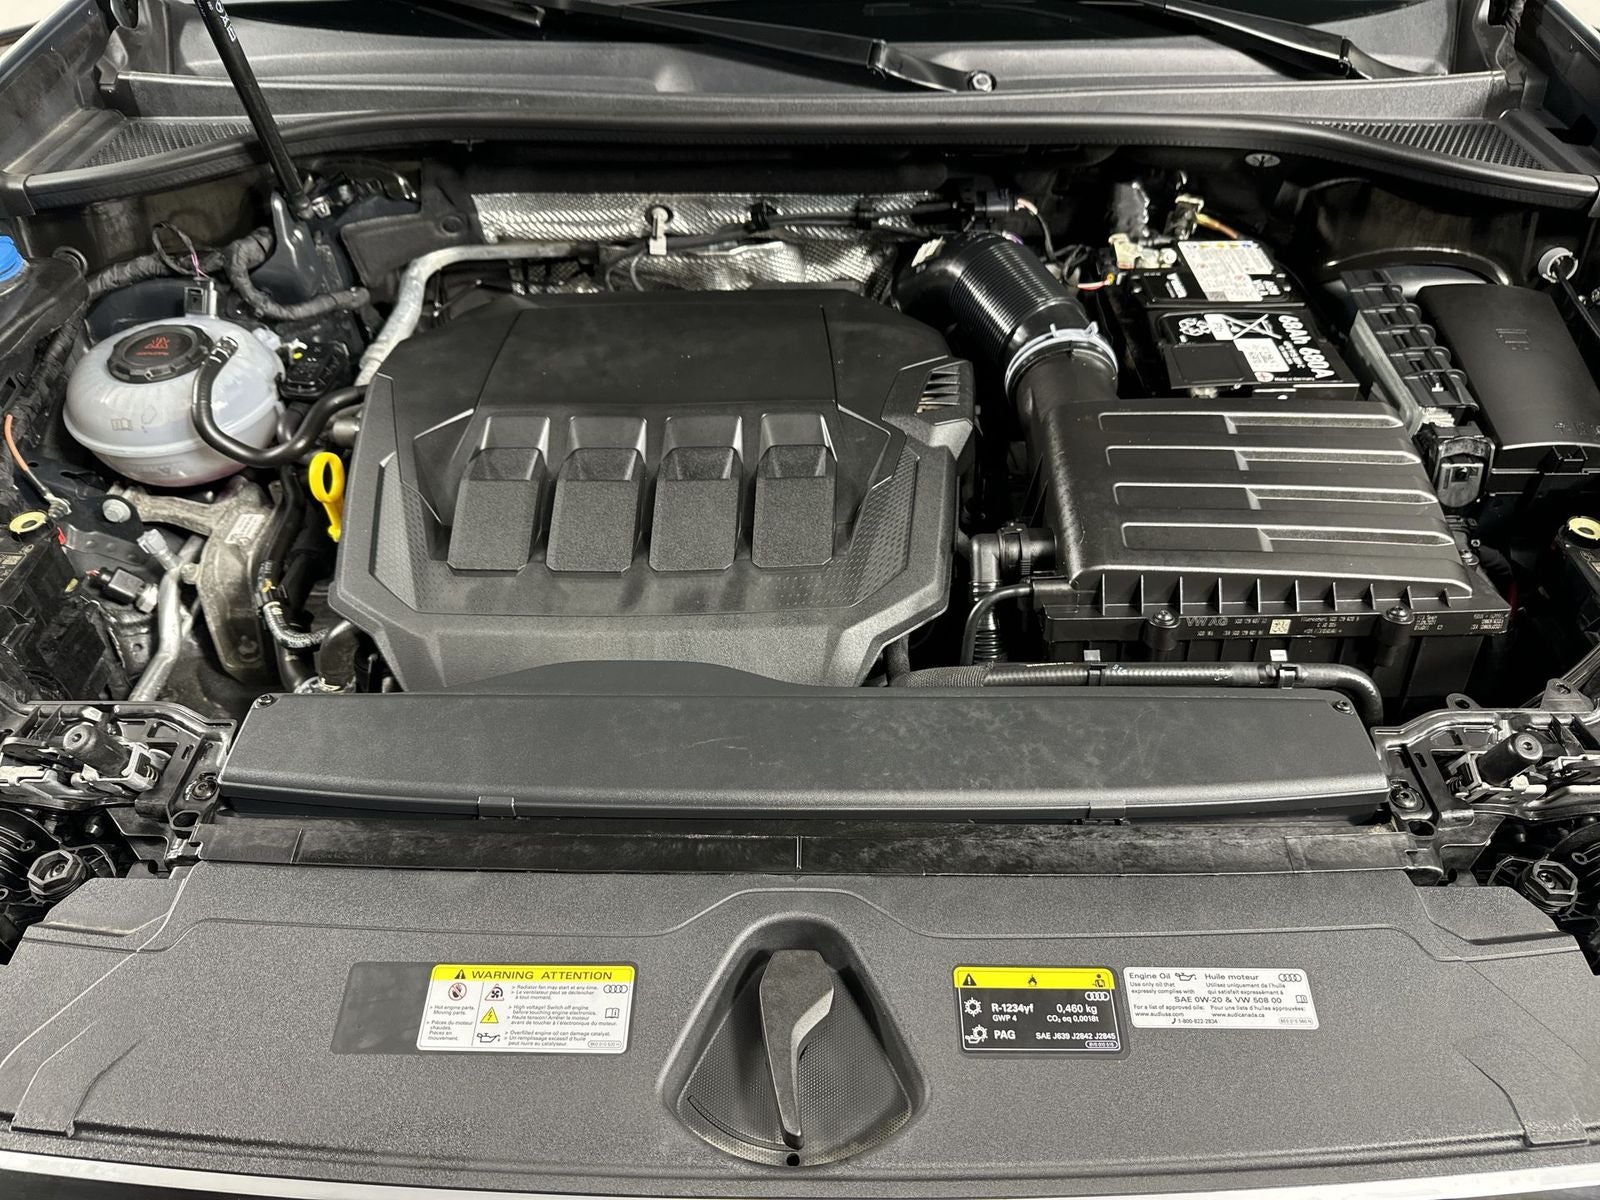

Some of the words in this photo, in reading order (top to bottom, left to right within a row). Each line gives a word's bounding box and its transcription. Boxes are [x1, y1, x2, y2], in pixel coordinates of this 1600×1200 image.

[1278, 315, 1312, 344] 68Ah
[1299, 347, 1334, 378] 680A
[472, 971, 534, 980] WARNING
[541, 971, 612, 980] ATTENTION
[991, 1003, 1034, 1014] R-1234yf
[1056, 1004, 1084, 1014] 0,460
[1085, 1004, 1098, 1015] kg
[994, 1030, 1016, 1040] PAG
[1052, 1032, 1071, 1040] J639
